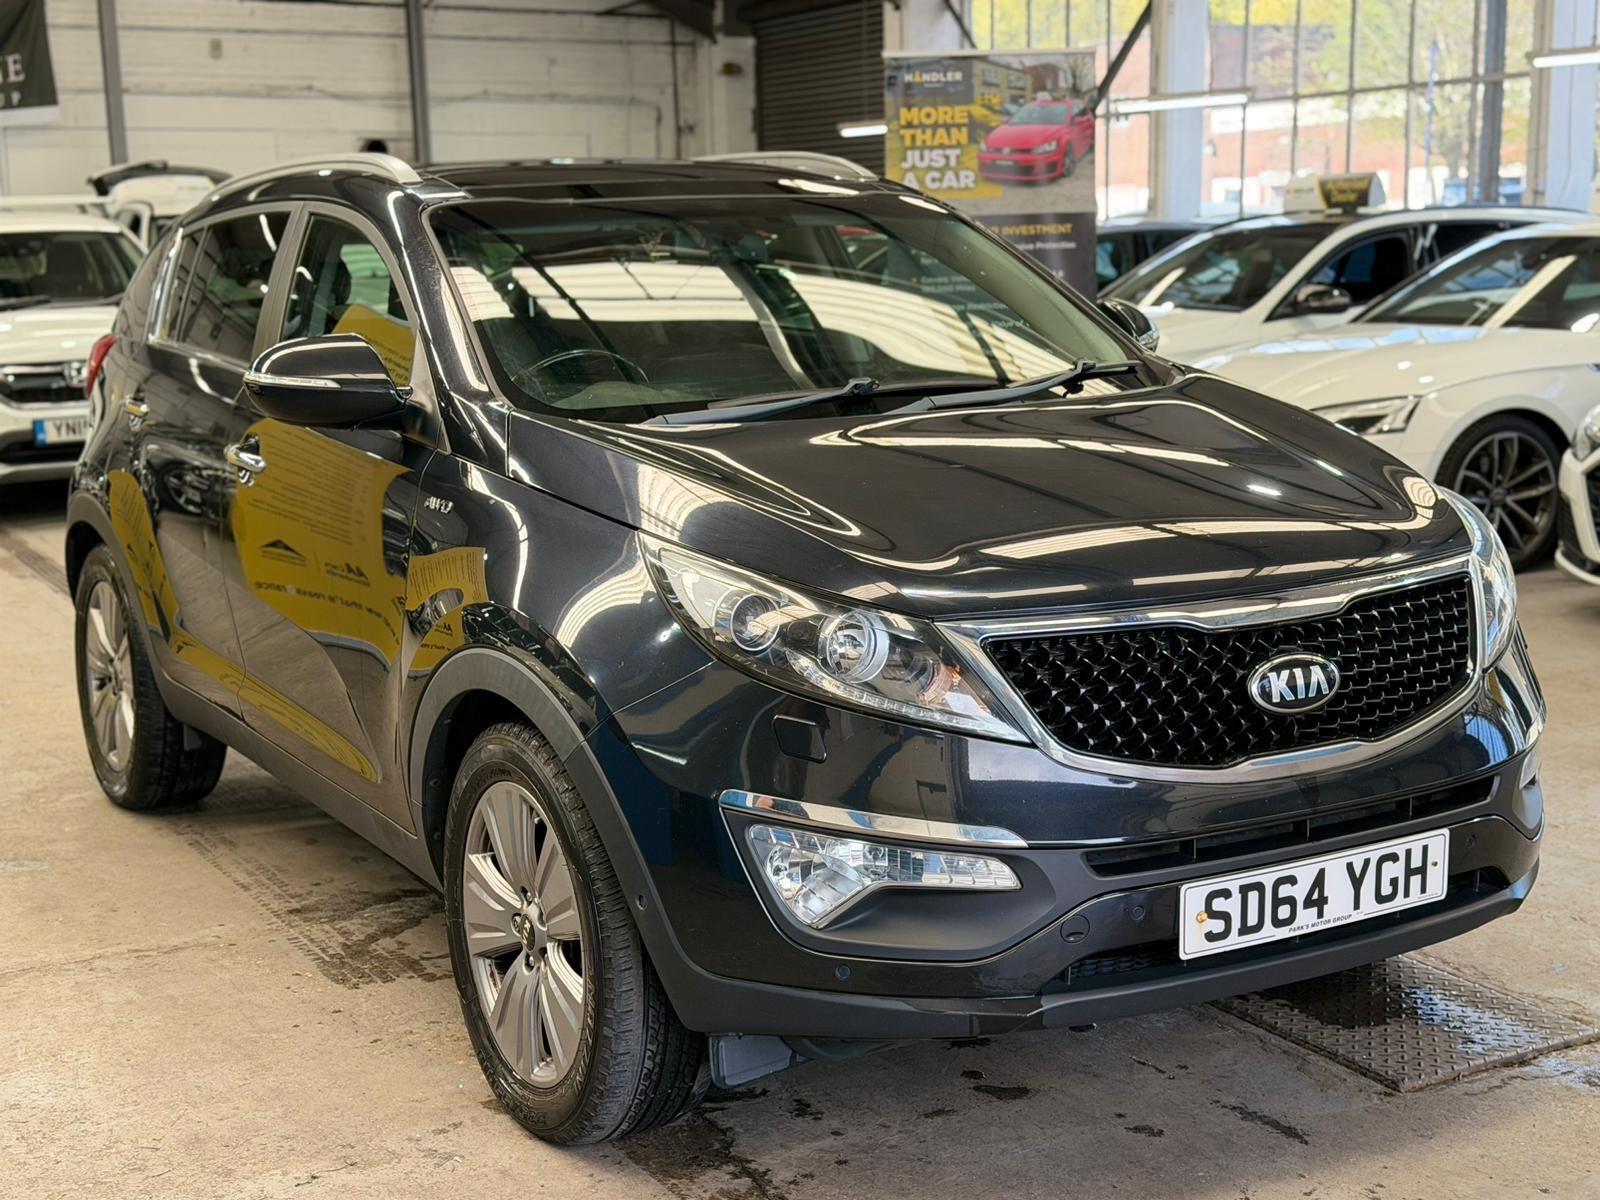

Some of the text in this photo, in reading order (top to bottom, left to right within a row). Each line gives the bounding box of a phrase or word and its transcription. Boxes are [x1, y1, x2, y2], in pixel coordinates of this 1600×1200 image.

[900, 106, 970, 126] MORE
[900, 127, 969, 147] THAN
[901, 148, 962, 169] JUST
[903, 170, 976, 190] A CAR
[1001, 223, 1073, 236] INVESTMENT
[423, 495, 455, 514] AWD
[1267, 665, 1329, 703] KIA
[1203, 843, 1429, 943] SD64 YGH
[1287, 922, 1310, 933] PARK'S
[1311, 917, 1332, 929] MOTOR
[1332, 913, 1353, 924] GROUP
